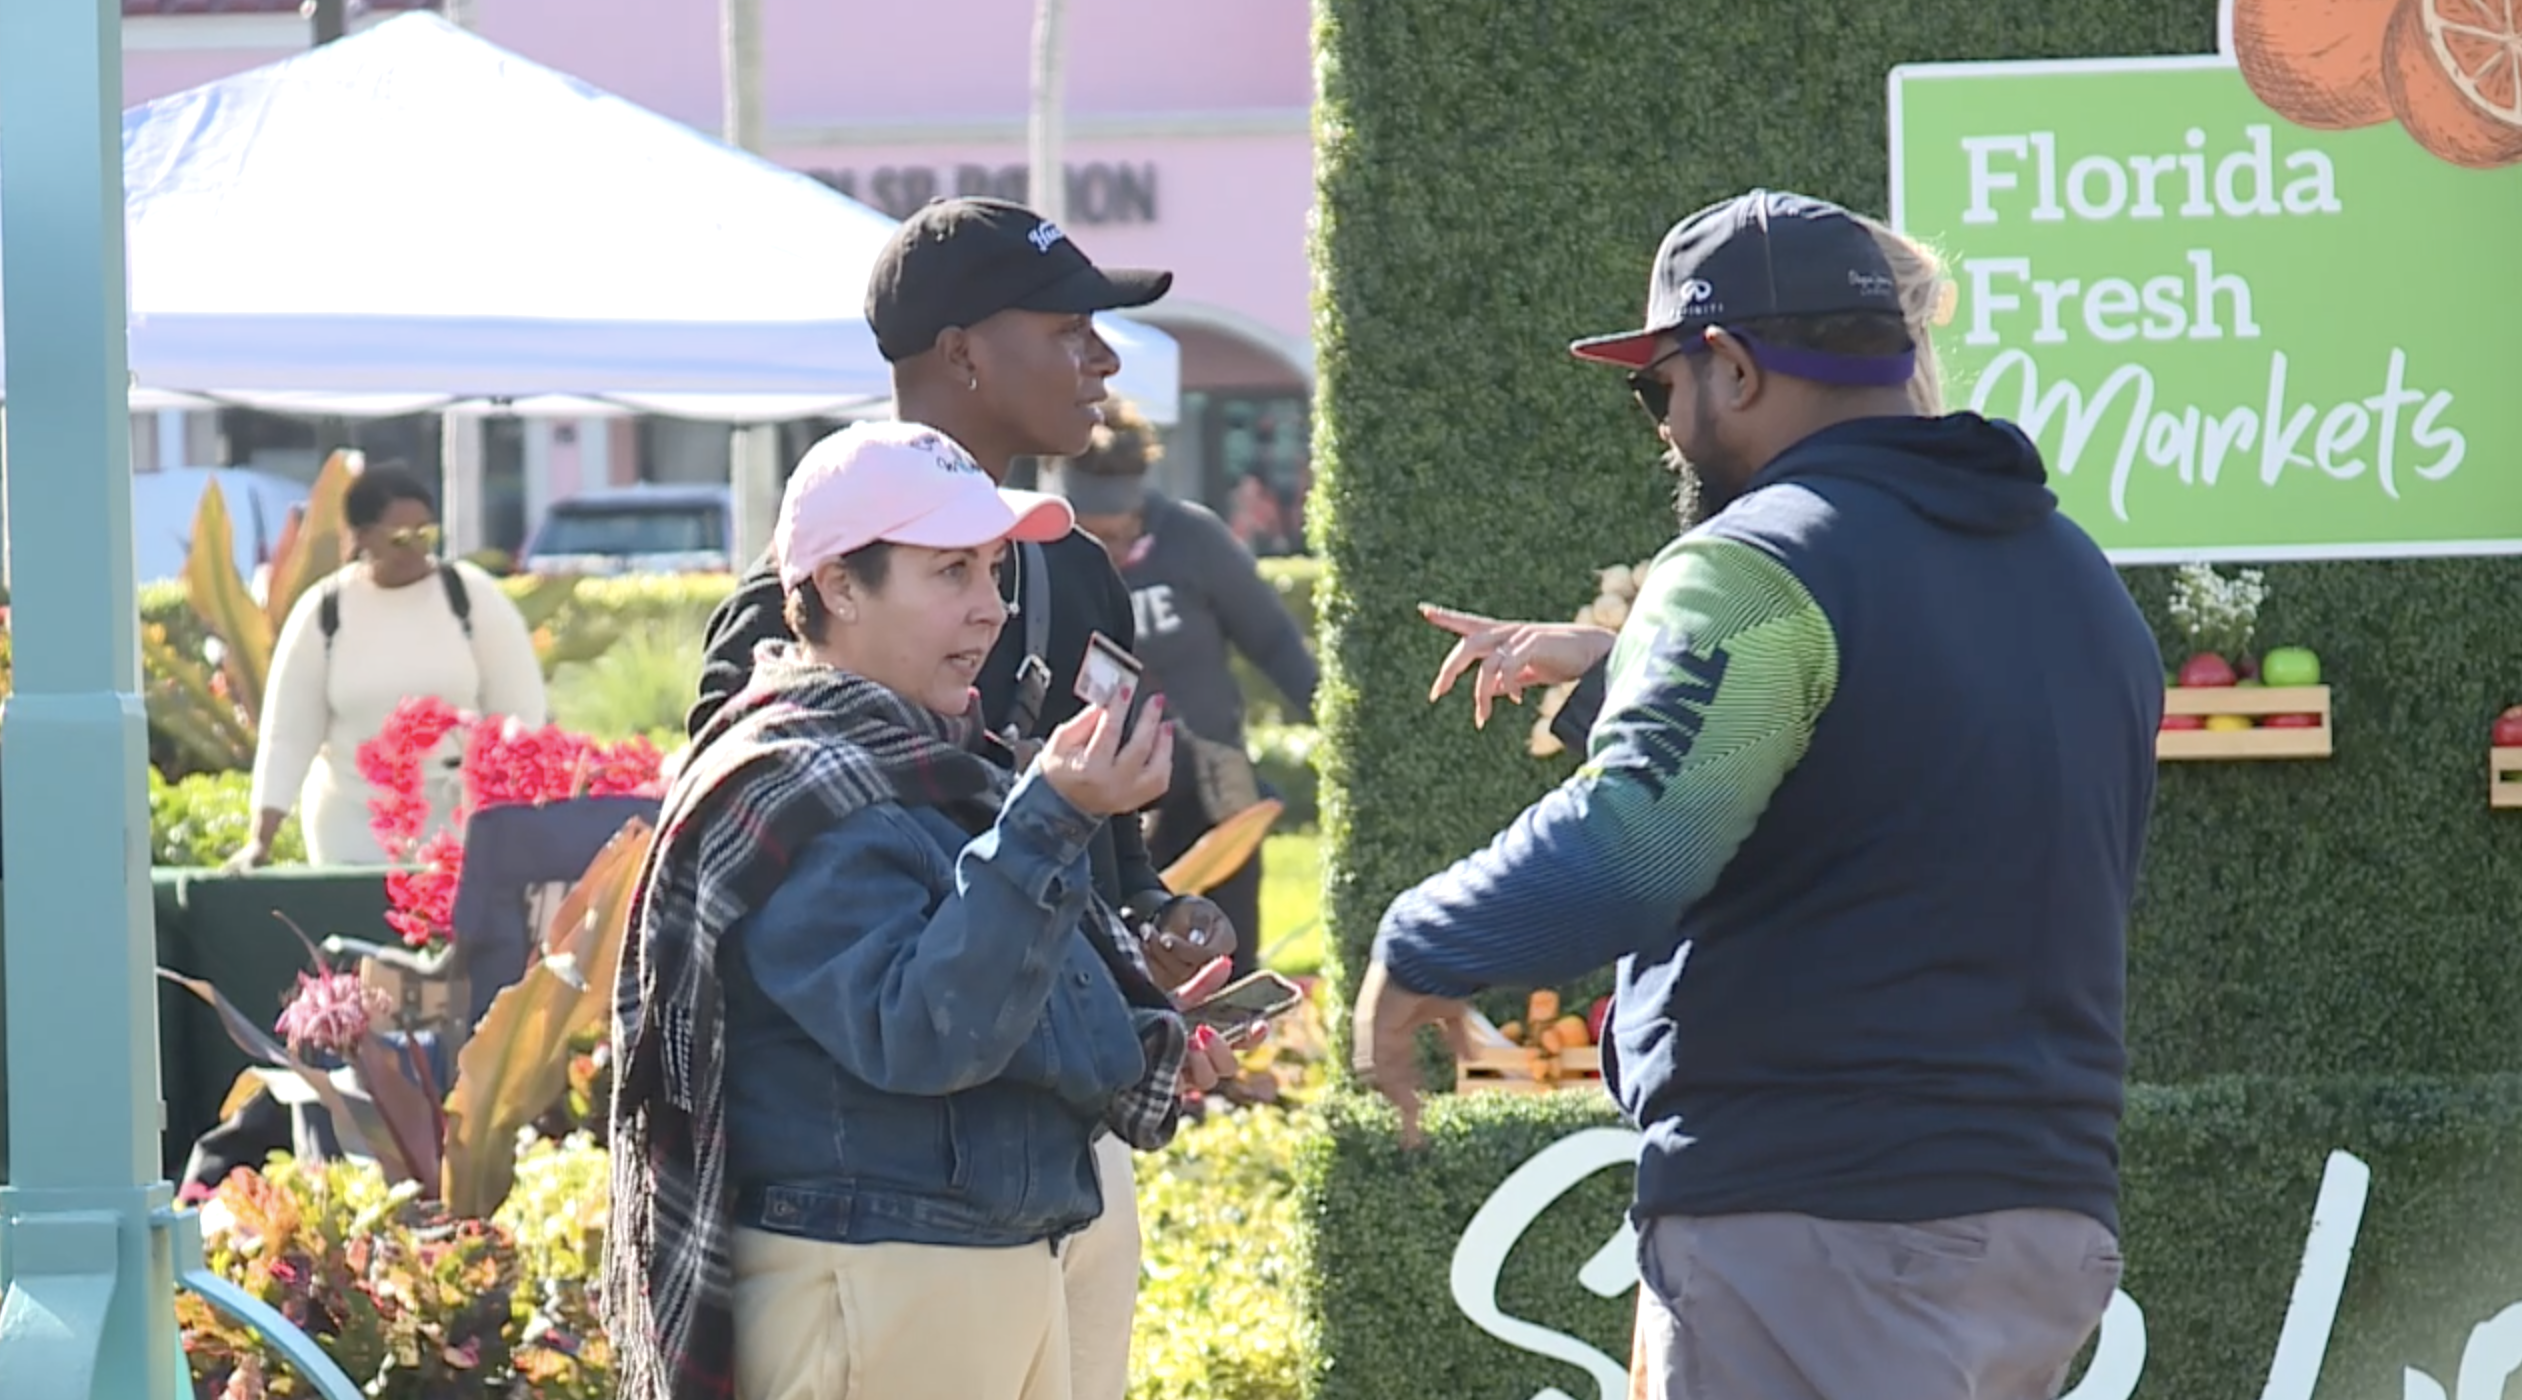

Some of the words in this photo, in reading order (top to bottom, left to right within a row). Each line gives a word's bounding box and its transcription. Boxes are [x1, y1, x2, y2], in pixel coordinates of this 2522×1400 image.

[1960, 124, 2343, 225] Florida
[1962, 249, 2261, 347] Fresh
[1968, 346, 2467, 522] Markets
